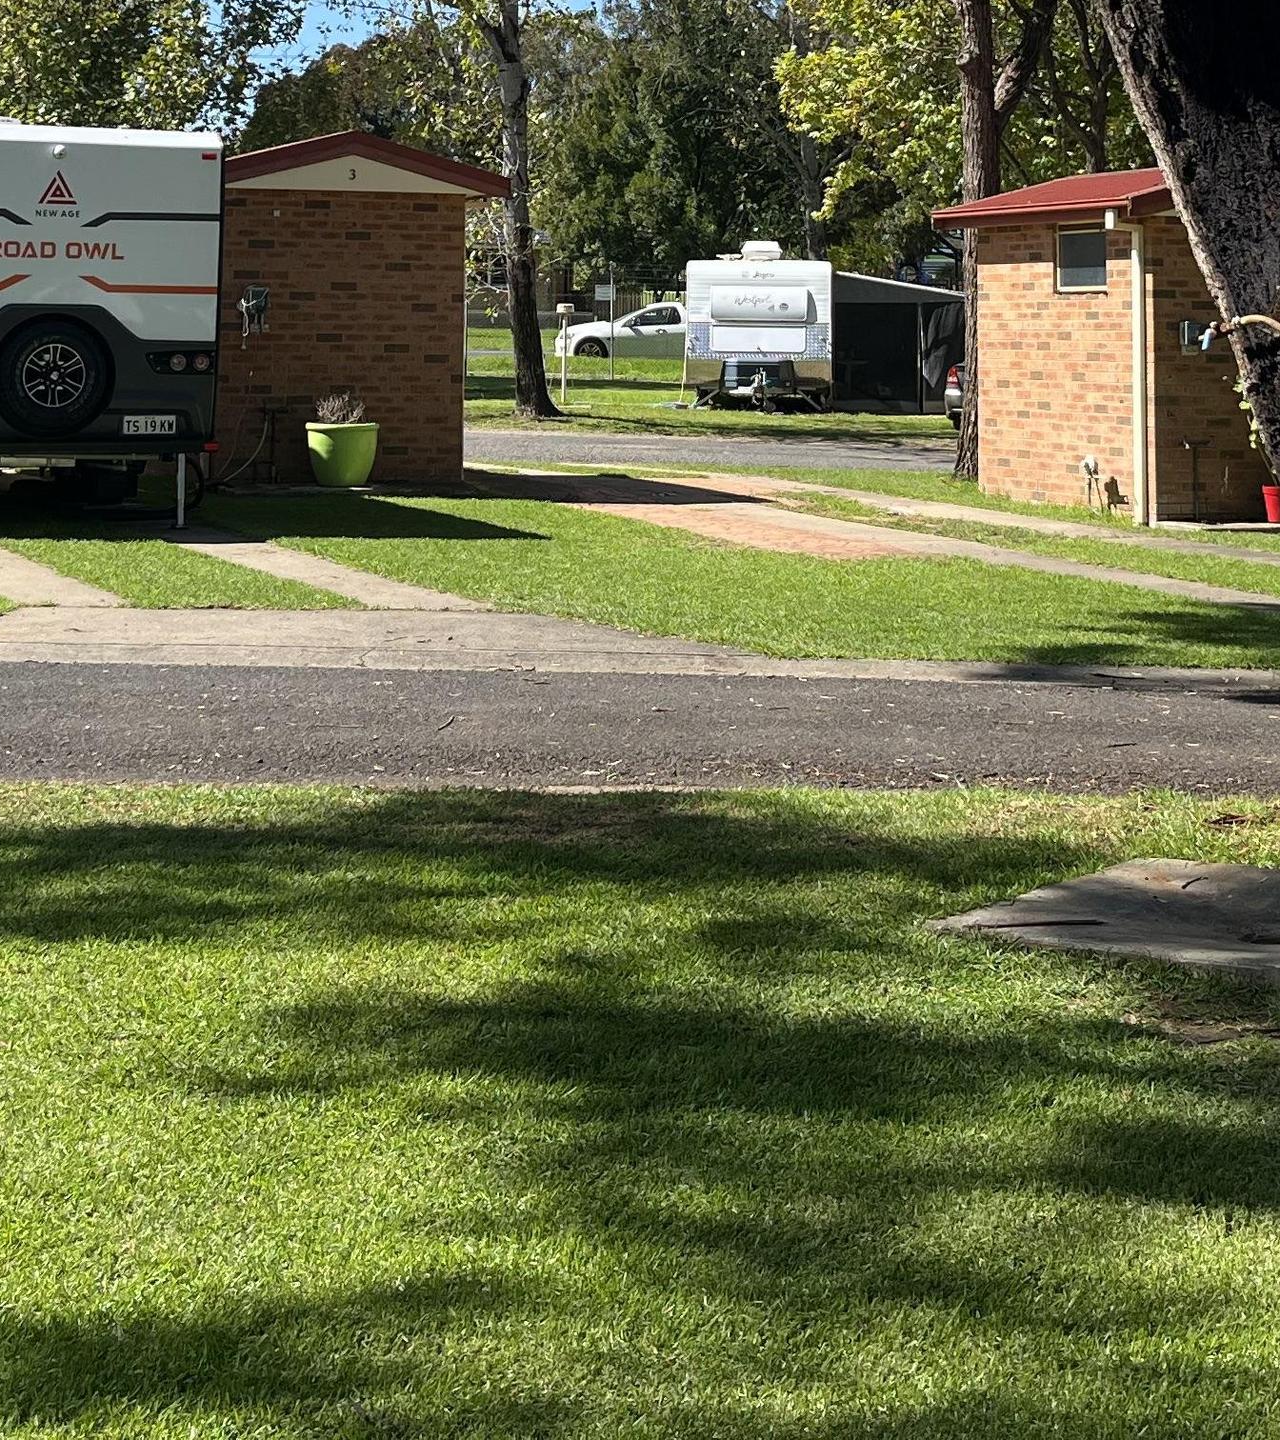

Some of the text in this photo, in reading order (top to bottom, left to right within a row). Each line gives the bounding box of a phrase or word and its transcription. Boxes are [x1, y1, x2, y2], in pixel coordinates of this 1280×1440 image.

[348, 168, 356, 181] 3
[35, 209, 80, 218] NEW AGE
[65, 242, 125, 260] OWL
[125, 420, 140, 433] TS
[144, 420, 157, 433] 19
